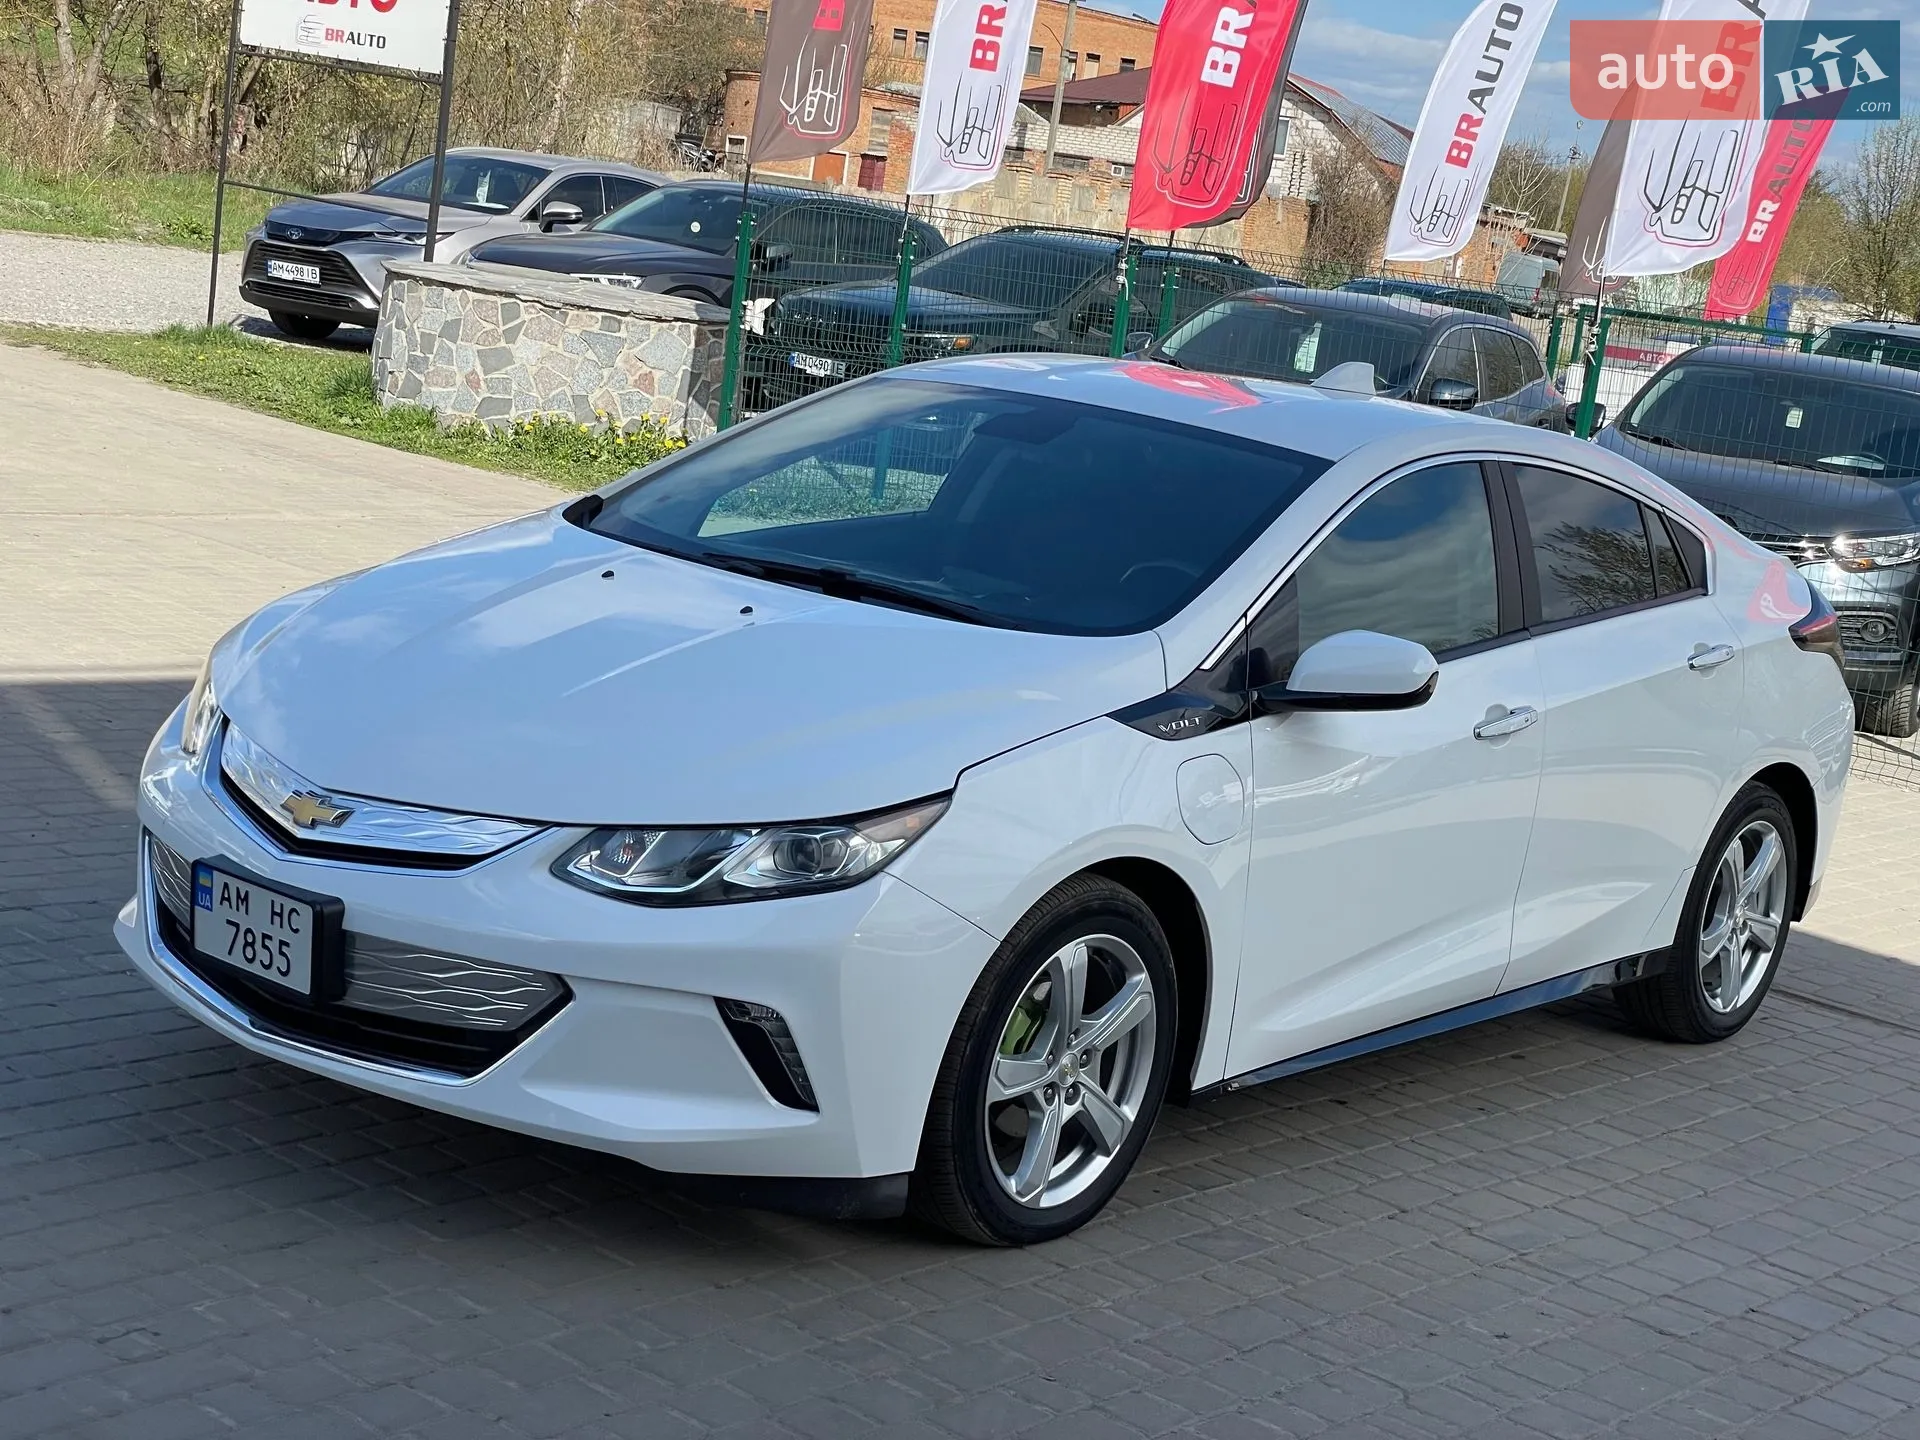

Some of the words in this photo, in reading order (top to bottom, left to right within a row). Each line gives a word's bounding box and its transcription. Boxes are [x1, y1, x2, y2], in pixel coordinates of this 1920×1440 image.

[325, 28, 386, 49] BRAUTO
[970, 0, 1008, 72] BR
[1200, 0, 1257, 88] BR
[1445, 3, 1523, 168] BRAUTO
[1746, 109, 1817, 243] BRAUTO
[285, 264, 305, 278] 4498
[1158, 716, 1202, 732] VOLT
[198, 892, 212, 909] UA
[219, 882, 250, 915] AM
[270, 900, 301, 934] HC
[226, 919, 291, 977] 7855
